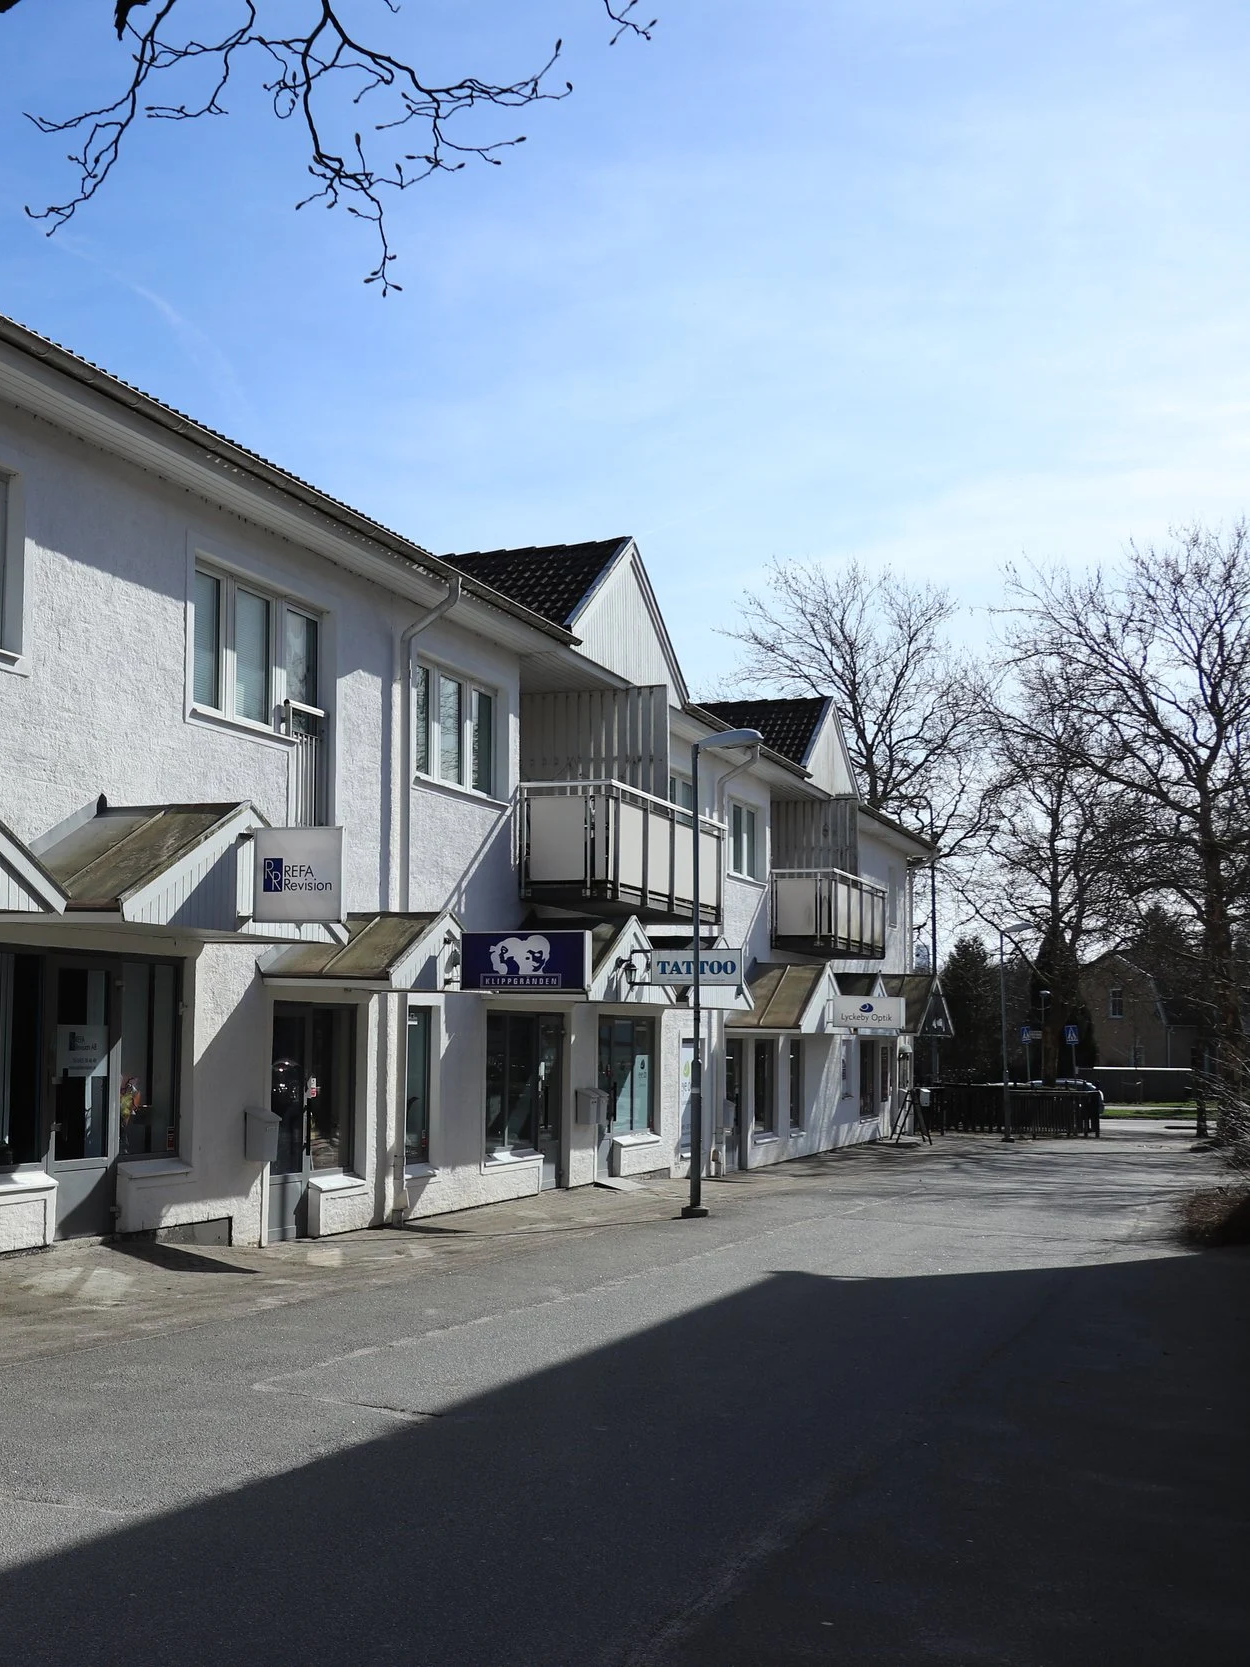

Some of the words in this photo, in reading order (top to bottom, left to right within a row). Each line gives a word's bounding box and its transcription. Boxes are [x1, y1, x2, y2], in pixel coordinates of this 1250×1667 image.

[284, 865, 314, 878] REFA
[284, 878, 333, 891] Revision
[656, 960, 737, 975] TATTOO
[485, 976, 557, 985] KLIPPGRÄNDEN
[841, 1013, 870, 1023] Lyckeby
[871, 1013, 892, 1023] Optik
